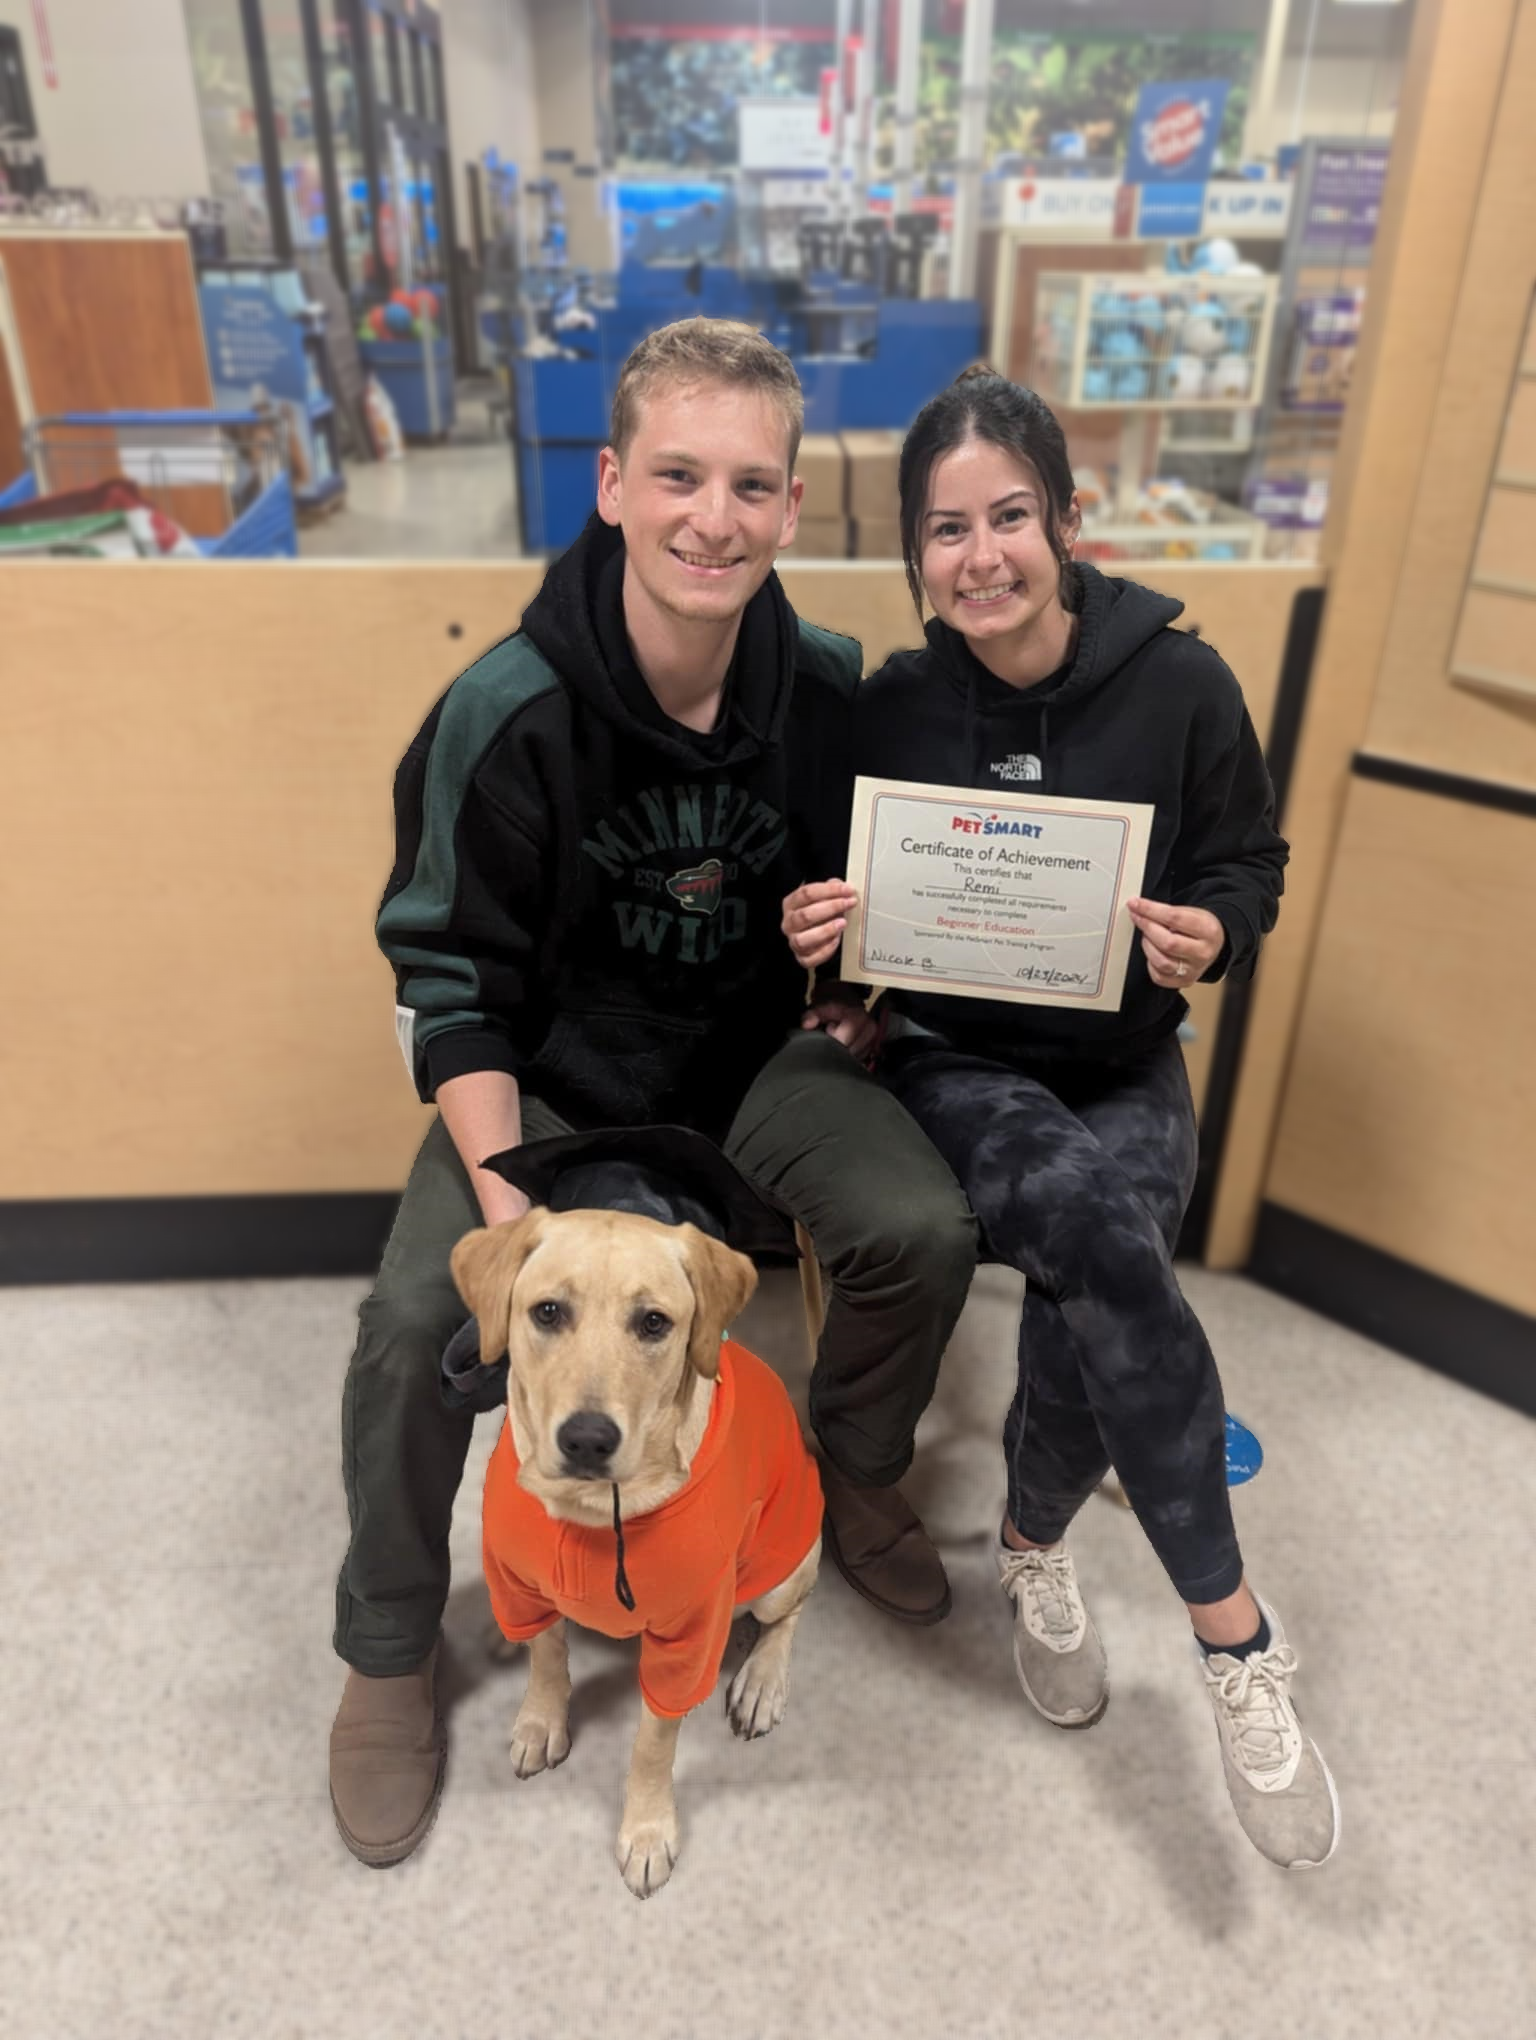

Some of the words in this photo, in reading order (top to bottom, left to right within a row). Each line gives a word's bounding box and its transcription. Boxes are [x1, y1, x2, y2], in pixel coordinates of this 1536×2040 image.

[1227, 195, 1257, 215] UP
[900, 837, 974, 860] Certificate
[978, 846, 995, 861] of
[997, 849, 1091, 871] Achievement
[953, 863, 972, 875] This
[974, 866, 1012, 879] certifies
[1014, 870, 1033, 881] that
[964, 876, 1002, 895] Remi
[912, 888, 924, 897] has
[926, 891, 966, 903] successfully
[968, 895, 1007, 905] completed
[1008, 898, 1017, 906] all
[1019, 900, 1067, 912] requirements
[947, 906, 982, 916] necessary
[993, 911, 1027, 920] complete
[936, 915, 979, 929] Beginner
[984, 921, 1035, 936] Education
